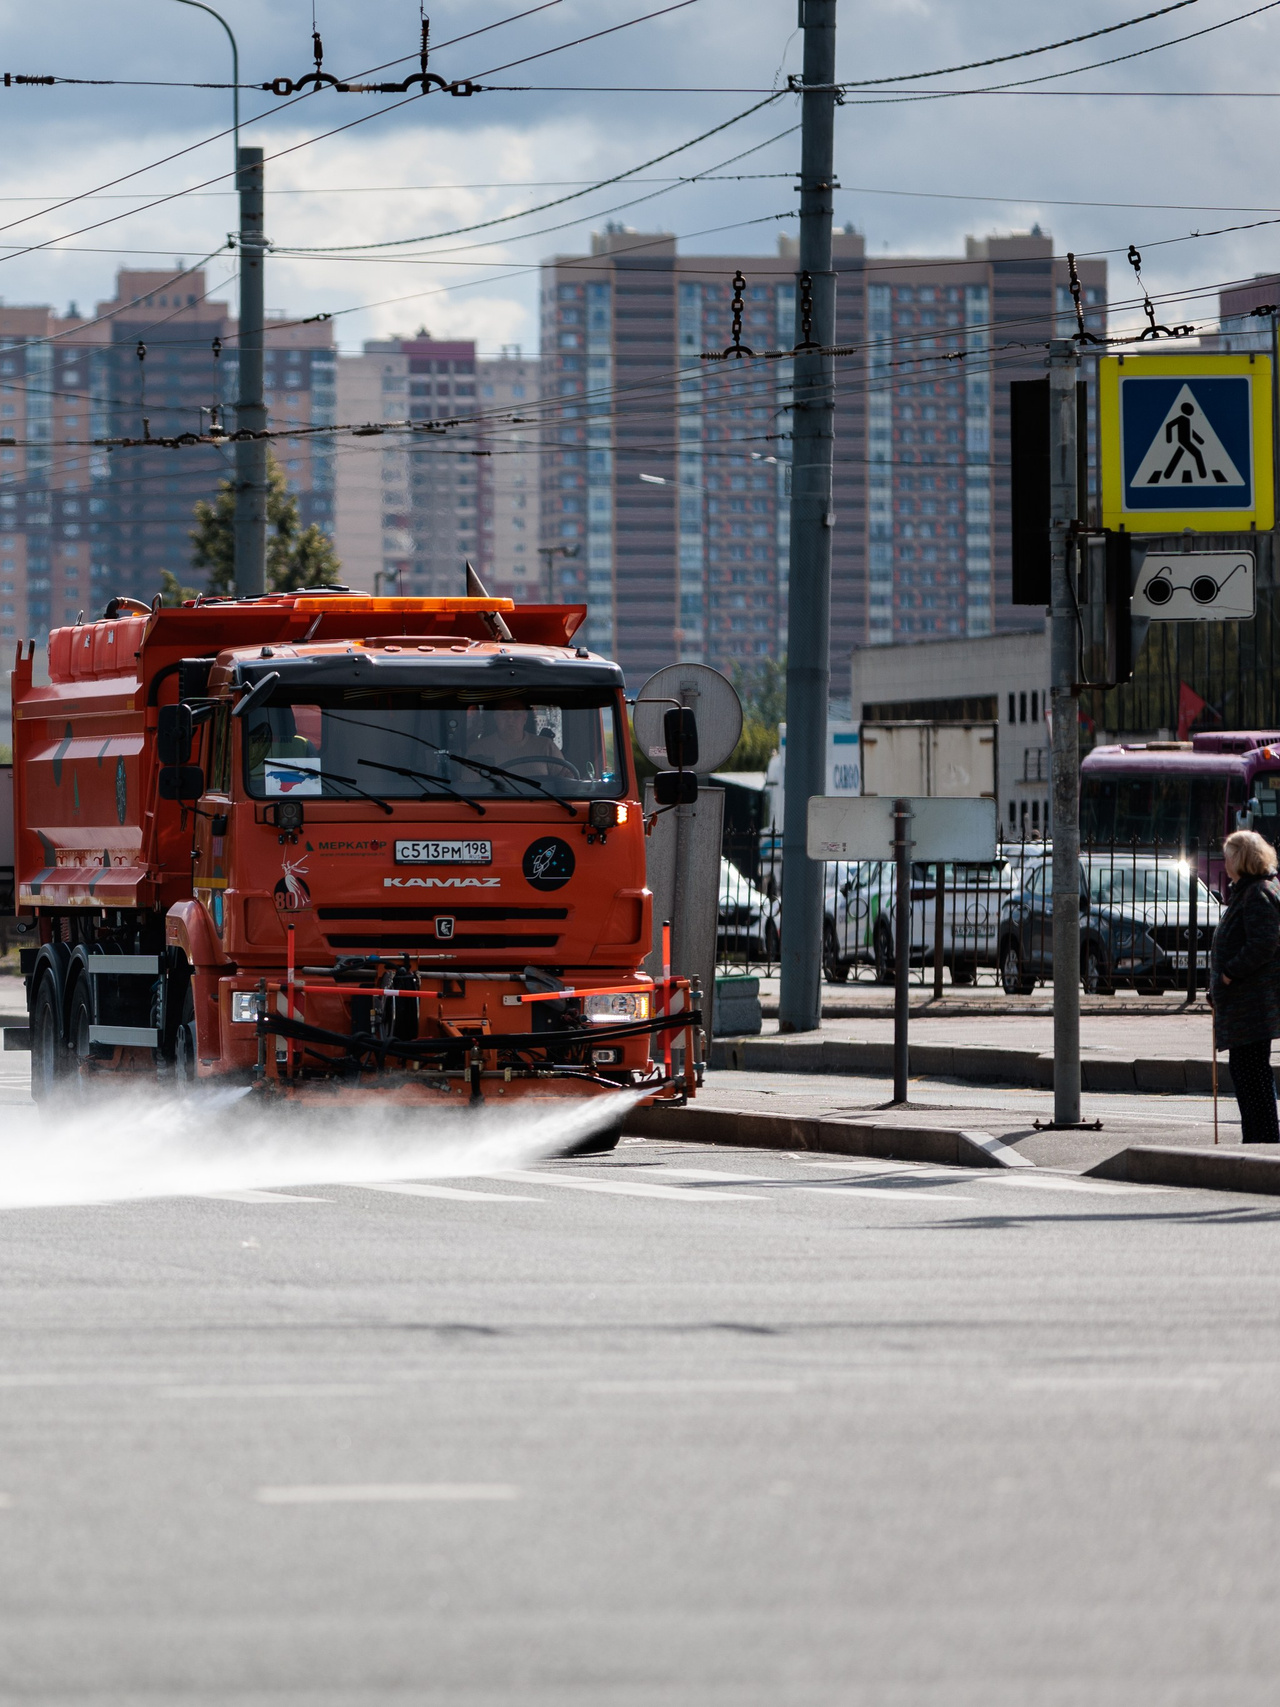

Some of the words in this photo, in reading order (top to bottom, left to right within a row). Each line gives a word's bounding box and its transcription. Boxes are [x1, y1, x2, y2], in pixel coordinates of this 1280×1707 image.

[464, 842, 488, 855] 198
[384, 878, 501, 887] KAMAZ
[274, 891, 296, 910] 80
